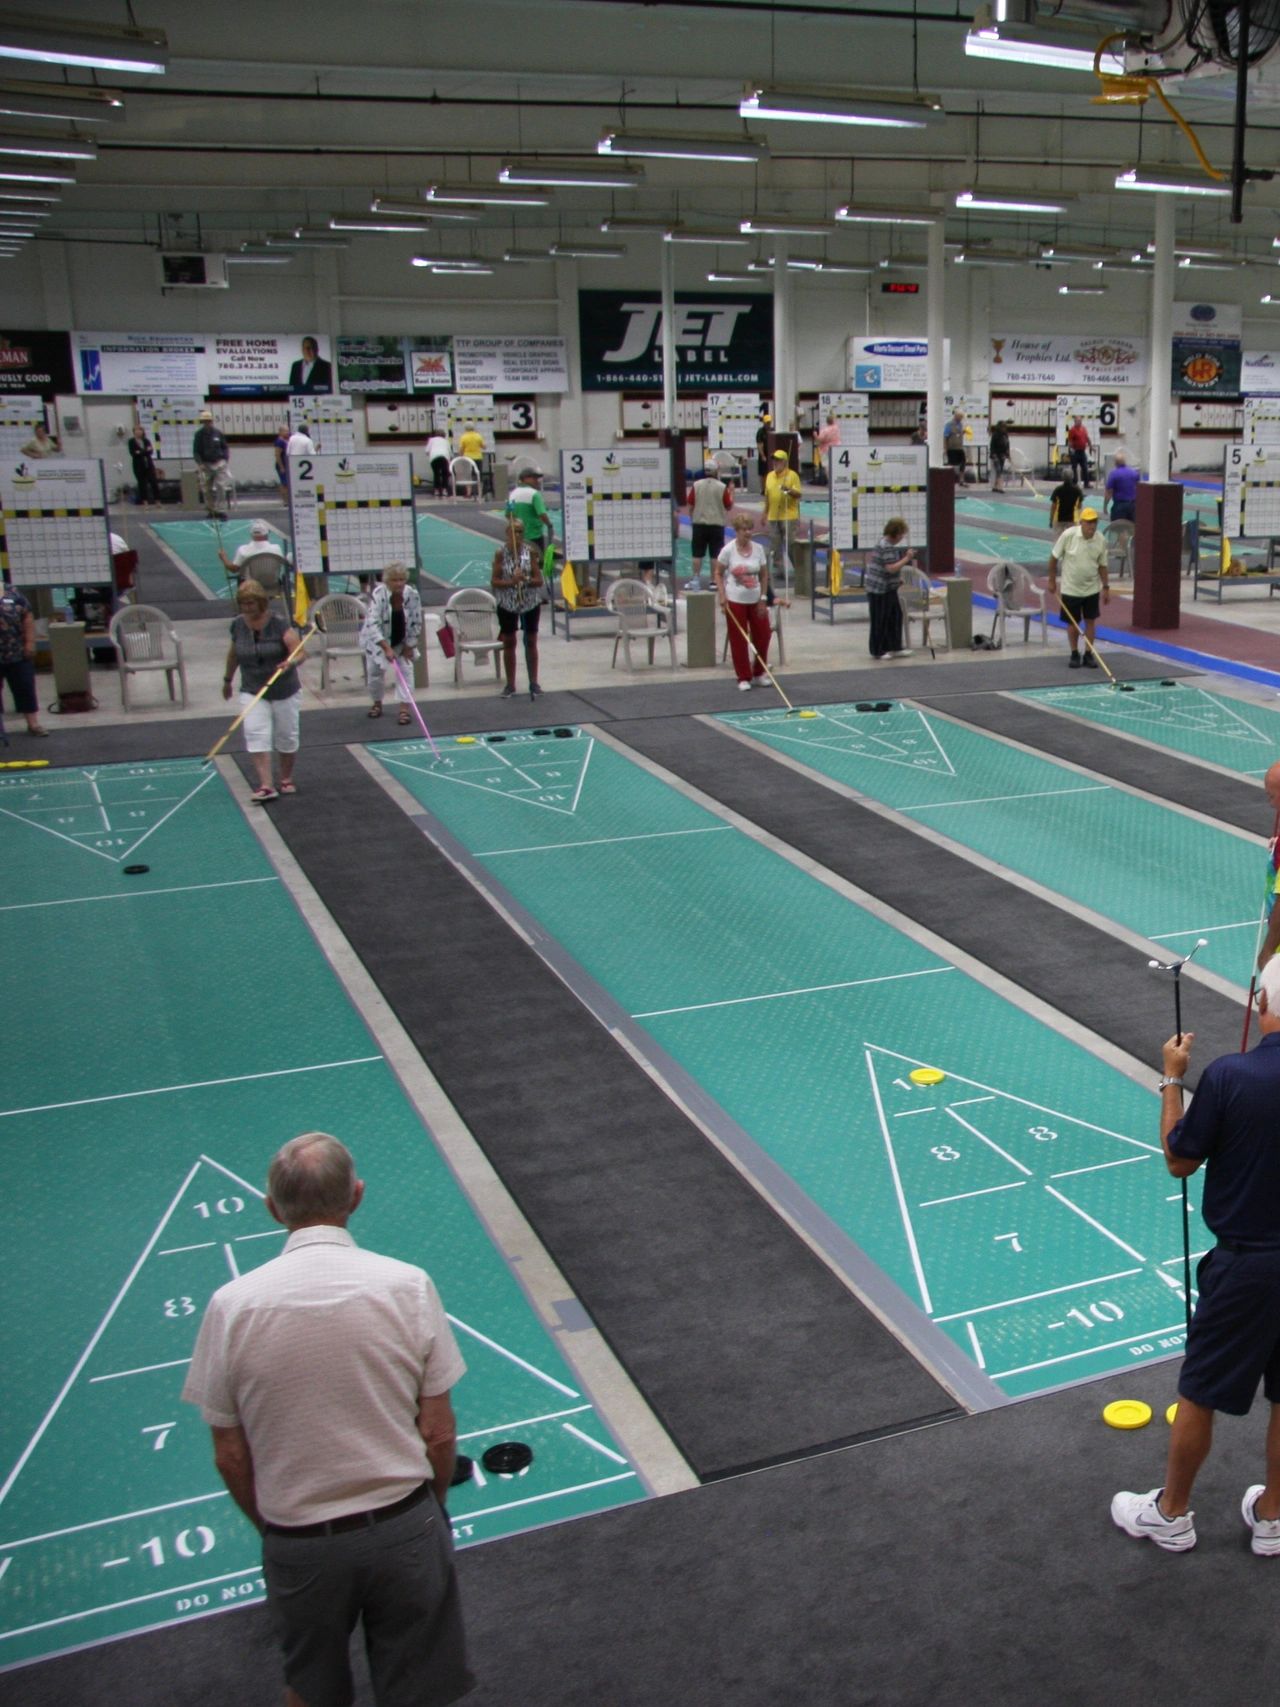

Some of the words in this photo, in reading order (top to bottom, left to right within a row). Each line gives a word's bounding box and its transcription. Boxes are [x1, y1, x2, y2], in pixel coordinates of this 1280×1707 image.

[602, 303, 753, 362] JET
[103, 345, 160, 353] INFORMATION
[216, 339, 244, 347] FREE
[246, 339, 278, 347] HOME
[473, 339, 502, 347] GROUP
[518, 339, 564, 347] COMPANIES
[1011, 340, 1038, 349] House
[1041, 341, 1053, 350] of
[1016, 352, 1053, 364] Trophies
[1055, 353, 1072, 363] Ltd.
[25, 374, 51, 383] GOOD
[596, 374, 665, 382] 1-866-440-51
[685, 373, 758, 382] JET-LABEL.COM
[140, 398, 154, 409] 14
[292, 398, 305, 408] 15
[437, 396, 449, 408] 16
[710, 396, 720, 405] 17
[821, 395, 831, 405] 18
[944, 396, 954, 405] 19
[1058, 397, 1068, 406] 20
[511, 403, 534, 430] 3
[1099, 403, 1116, 426] 6
[571, 454, 584, 474] 3
[838, 450, 851, 468] 4
[1232, 448, 1241, 465] 5
[298, 460, 314, 481] 2
[95, 837, 127, 848] 10
[1027, 1125, 1059, 1142] 8
[930, 1144, 961, 1161] 8
[192, 1195, 246, 1220] 10
[994, 1232, 1024, 1253] 7
[163, 1295, 197, 1318] 8
[1047, 1300, 1125, 1329] -10
[1128, 1343, 1155, 1356] DO
[140, 1421, 177, 1452] 7
[101, 1524, 216, 1569] -10
[175, 1591, 209, 1612] DO
